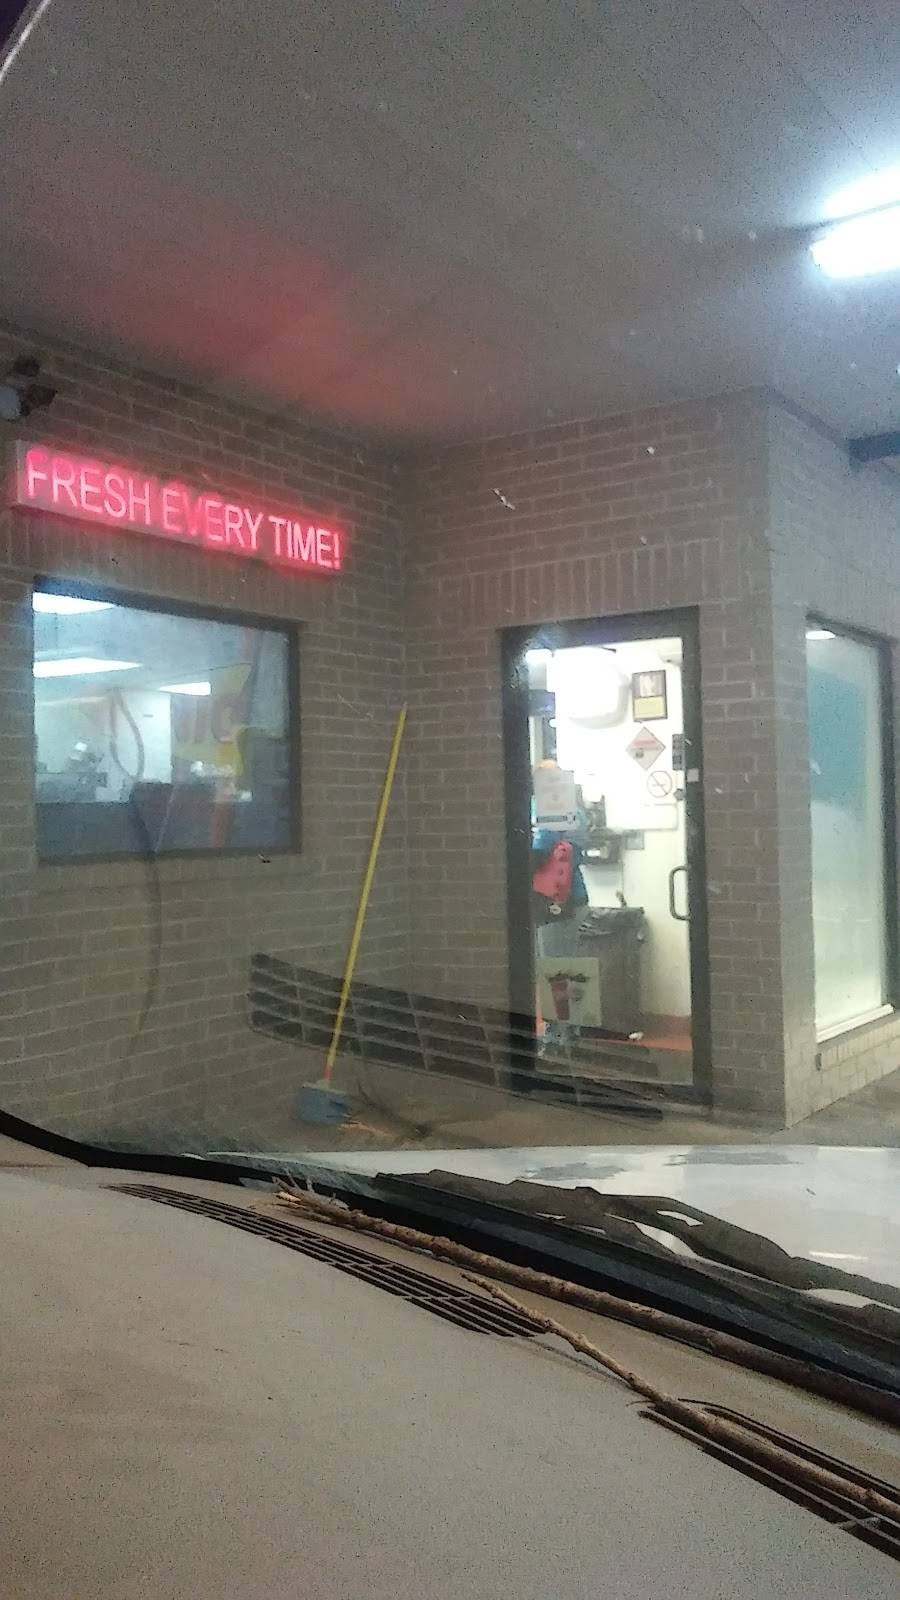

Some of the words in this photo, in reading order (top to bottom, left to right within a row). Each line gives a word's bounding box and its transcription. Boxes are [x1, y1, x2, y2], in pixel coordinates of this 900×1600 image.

[26, 448, 152, 525] FRESH
[162, 487, 264, 549] EVERY
[268, 514, 342, 570] TIME!
